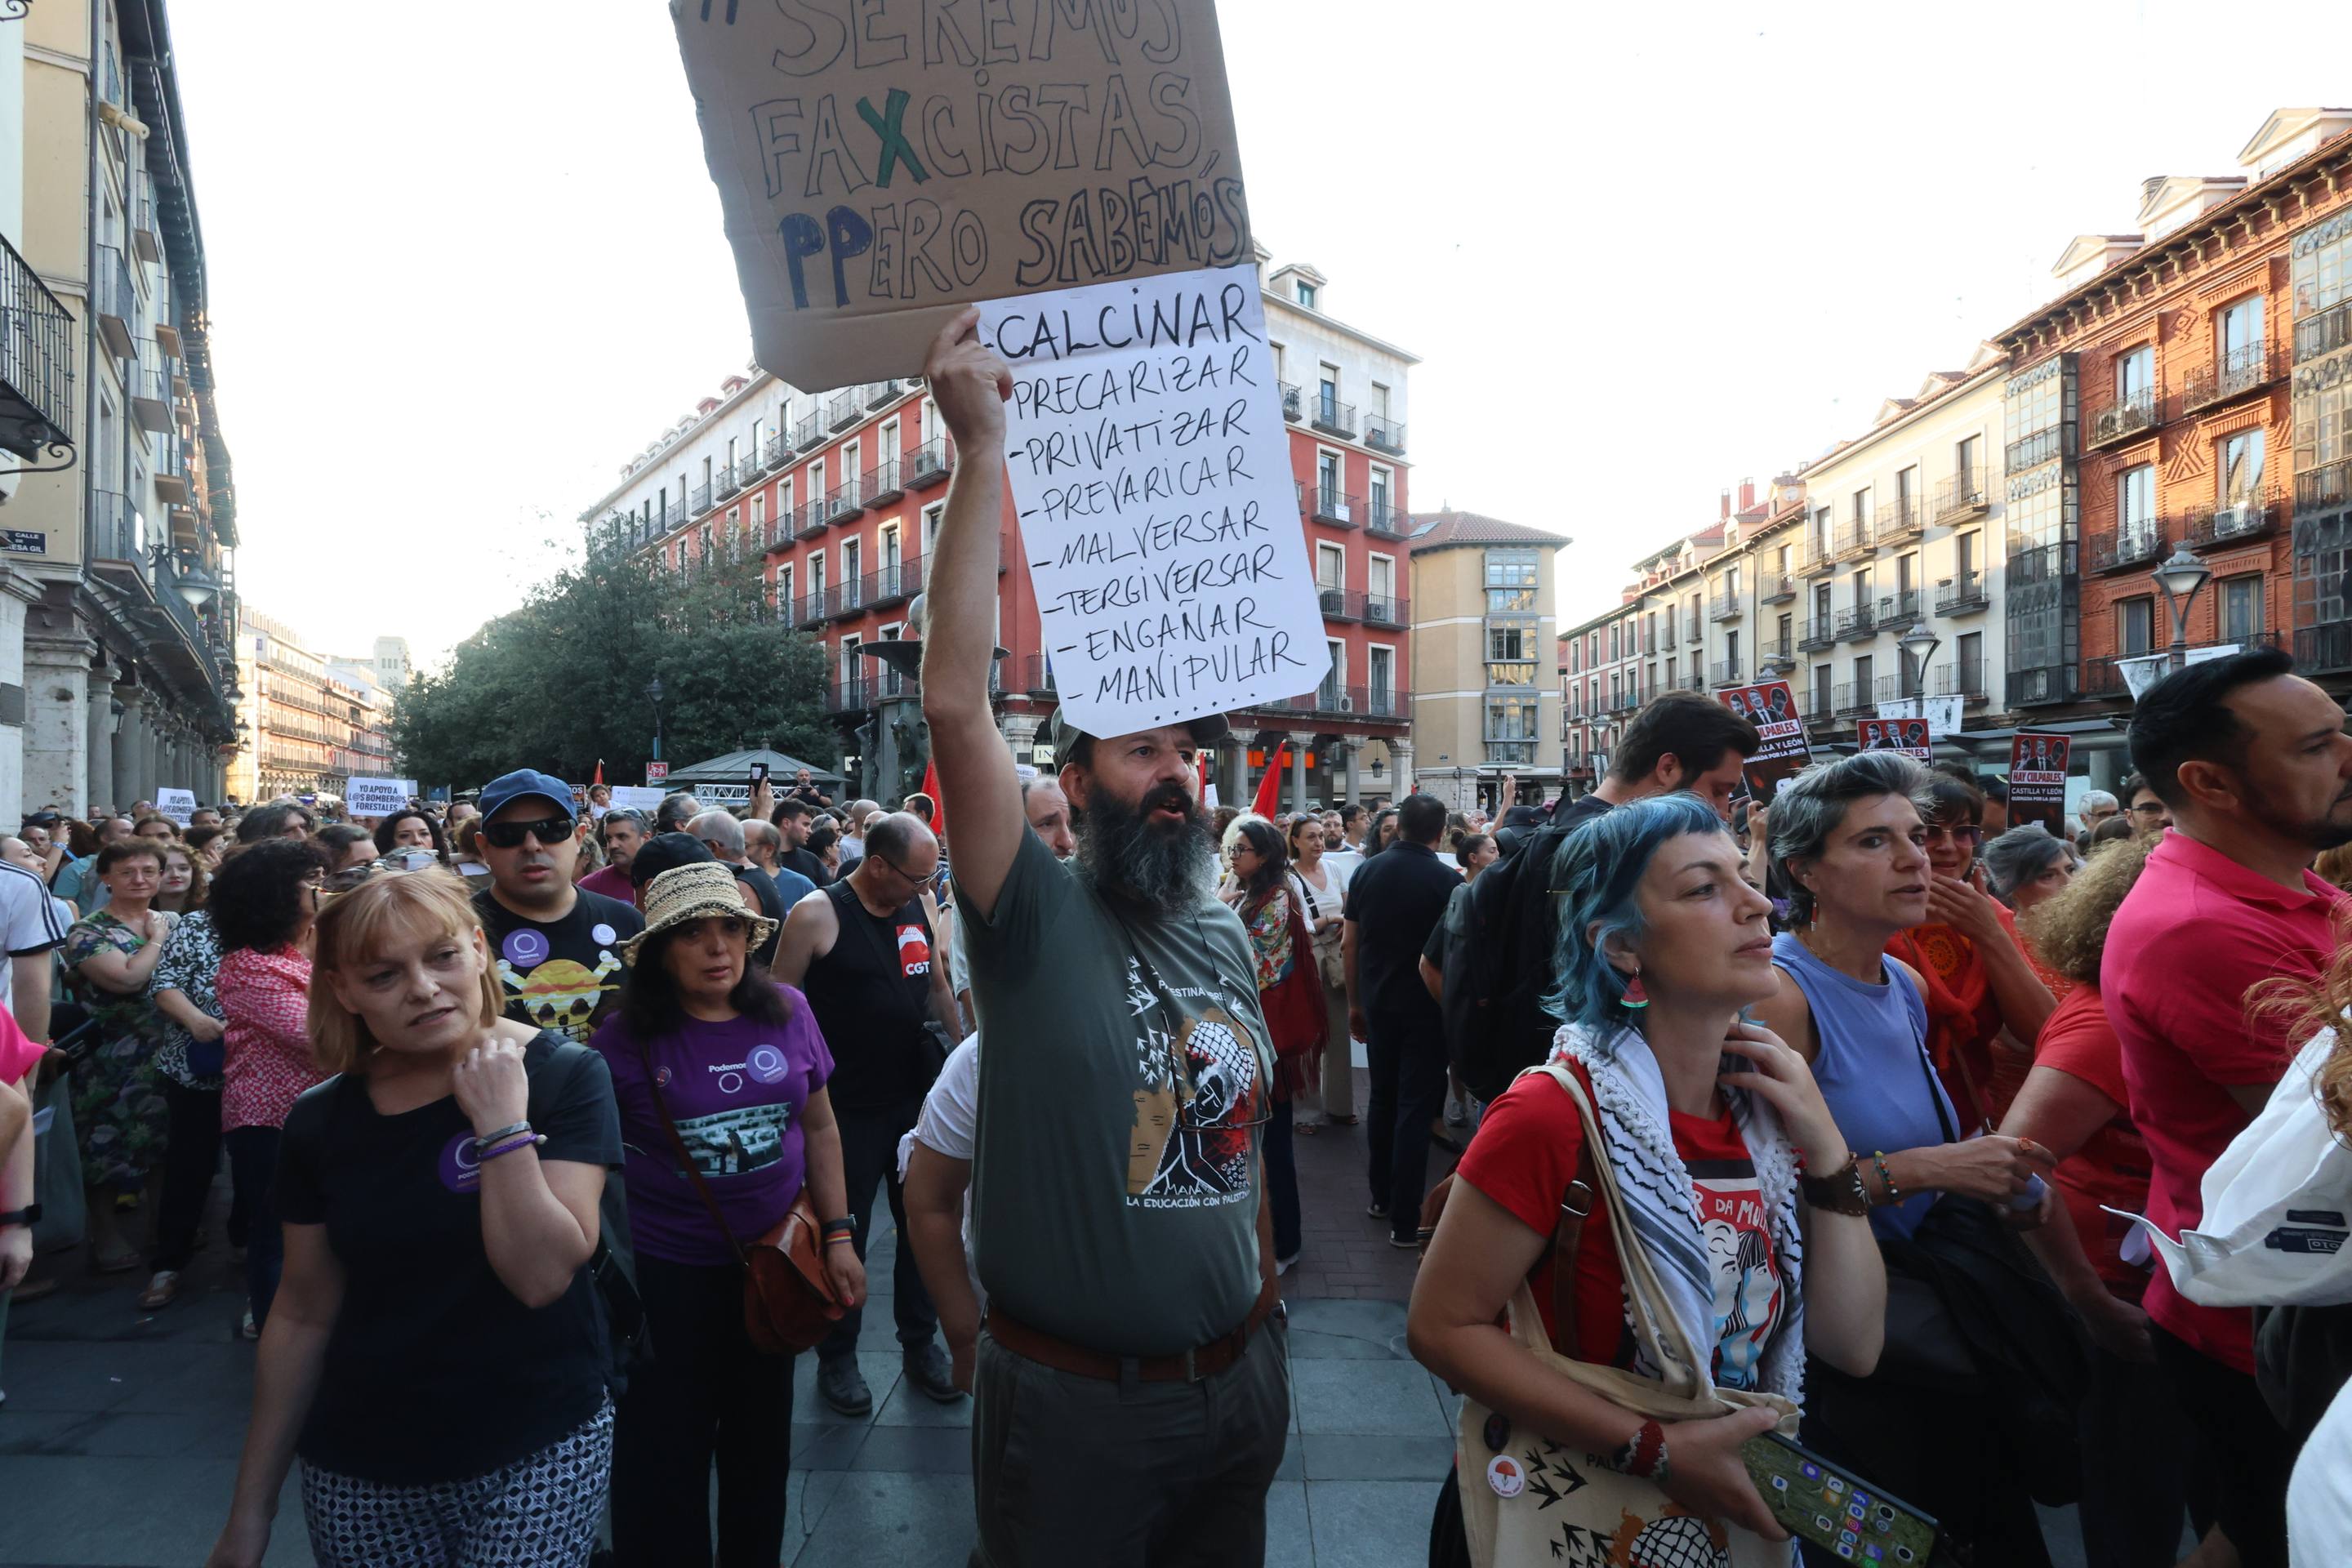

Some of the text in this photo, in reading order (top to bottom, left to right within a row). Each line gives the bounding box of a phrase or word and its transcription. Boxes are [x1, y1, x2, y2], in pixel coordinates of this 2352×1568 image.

[1017, 176, 1246, 287] SABEMOS
[1058, 500, 1268, 570] MALVERSAR
[1085, 597, 1276, 661] ENGAÑAR
[359, 785, 399, 795] YO APOYO A
[355, 802, 398, 812] FORESTALES
[905, 960, 930, 975] CGT
[1126, 1196, 1140, 1208] LA
[1143, 1195, 1200, 1209] EDUCACIÓN
[1202, 1196, 1220, 1206] CON
[1715, 1198, 1733, 1216] DA
